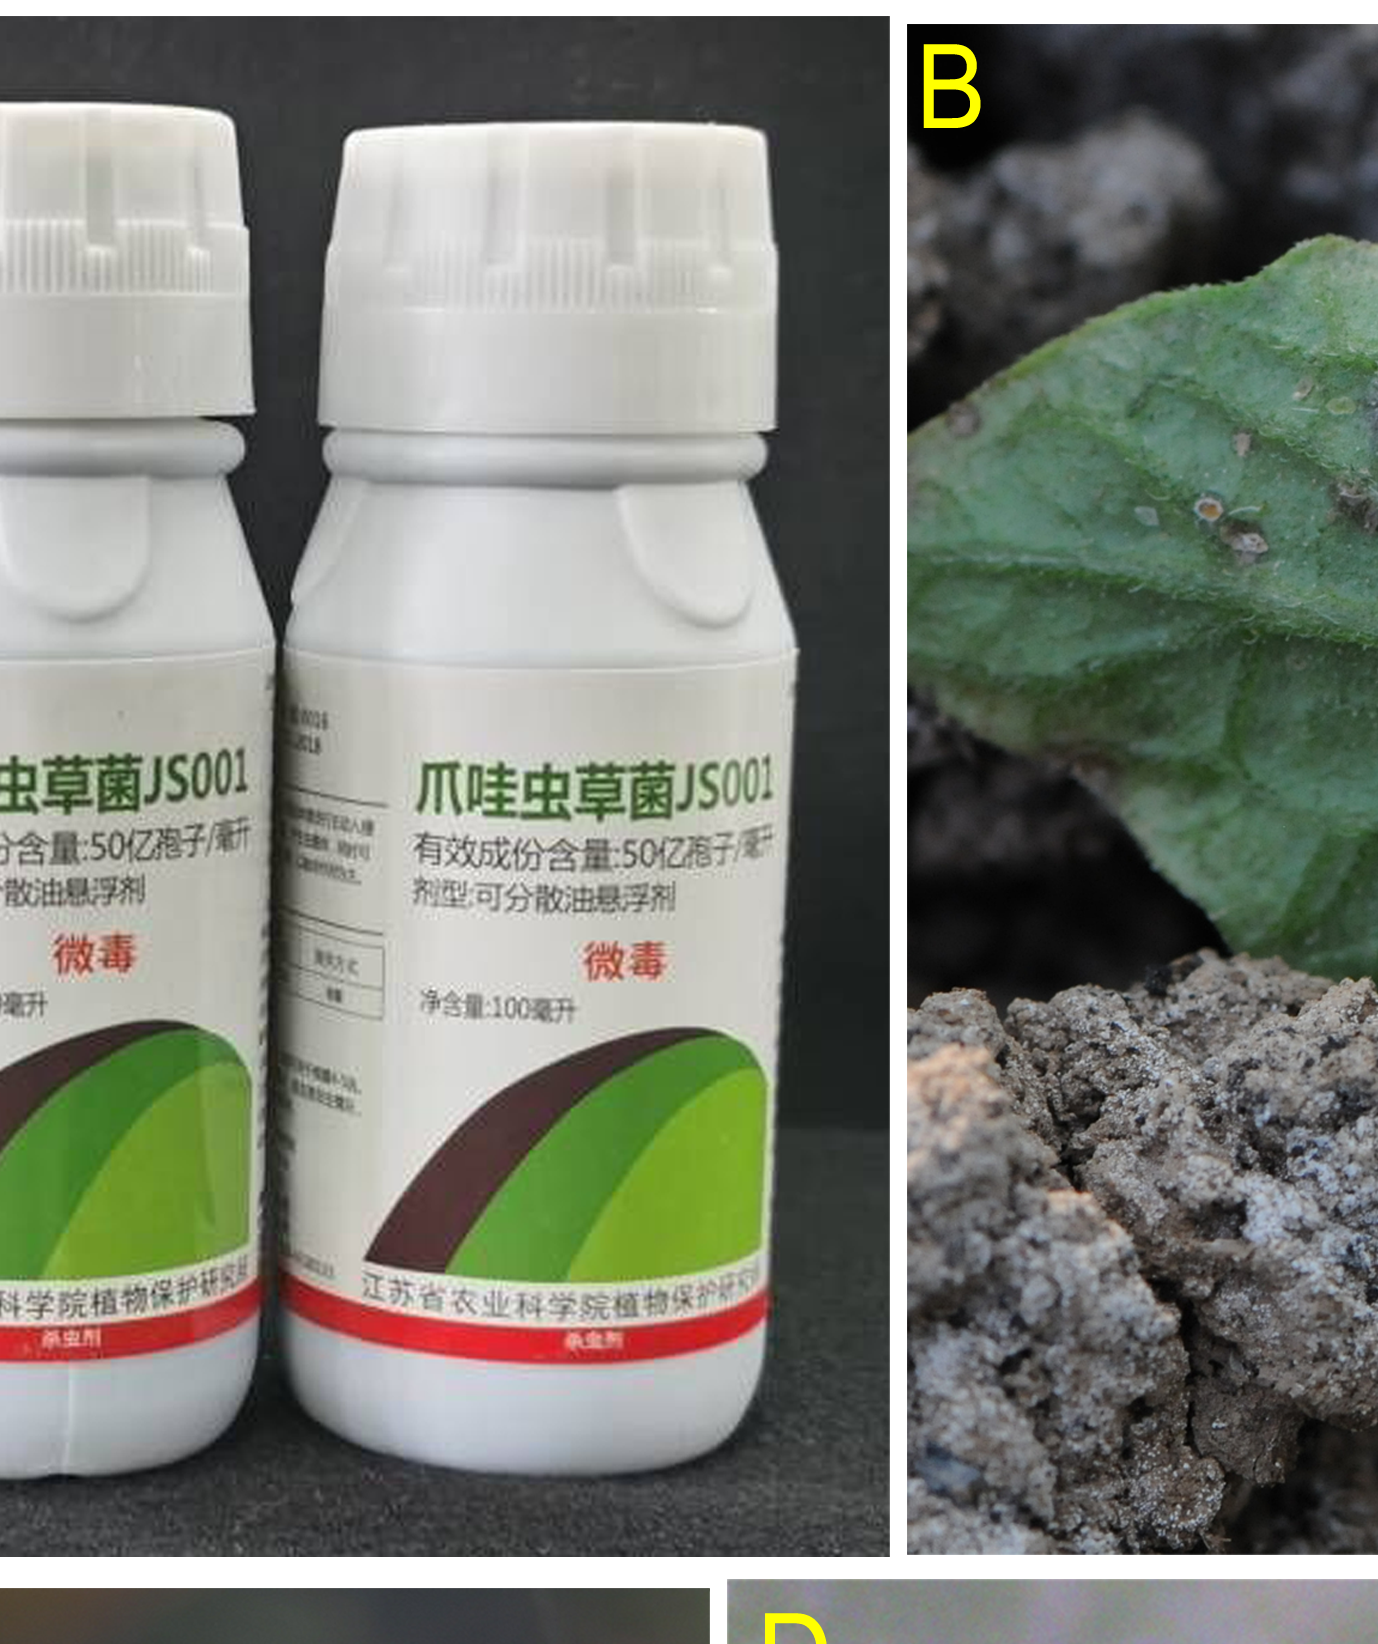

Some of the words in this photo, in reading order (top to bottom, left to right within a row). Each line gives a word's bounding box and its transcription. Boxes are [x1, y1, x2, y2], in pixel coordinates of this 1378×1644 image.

[416, 754, 775, 823] 爪哇虫草菌JS001
[52, 932, 138, 976] 微毒
[582, 940, 668, 982] 微毒
